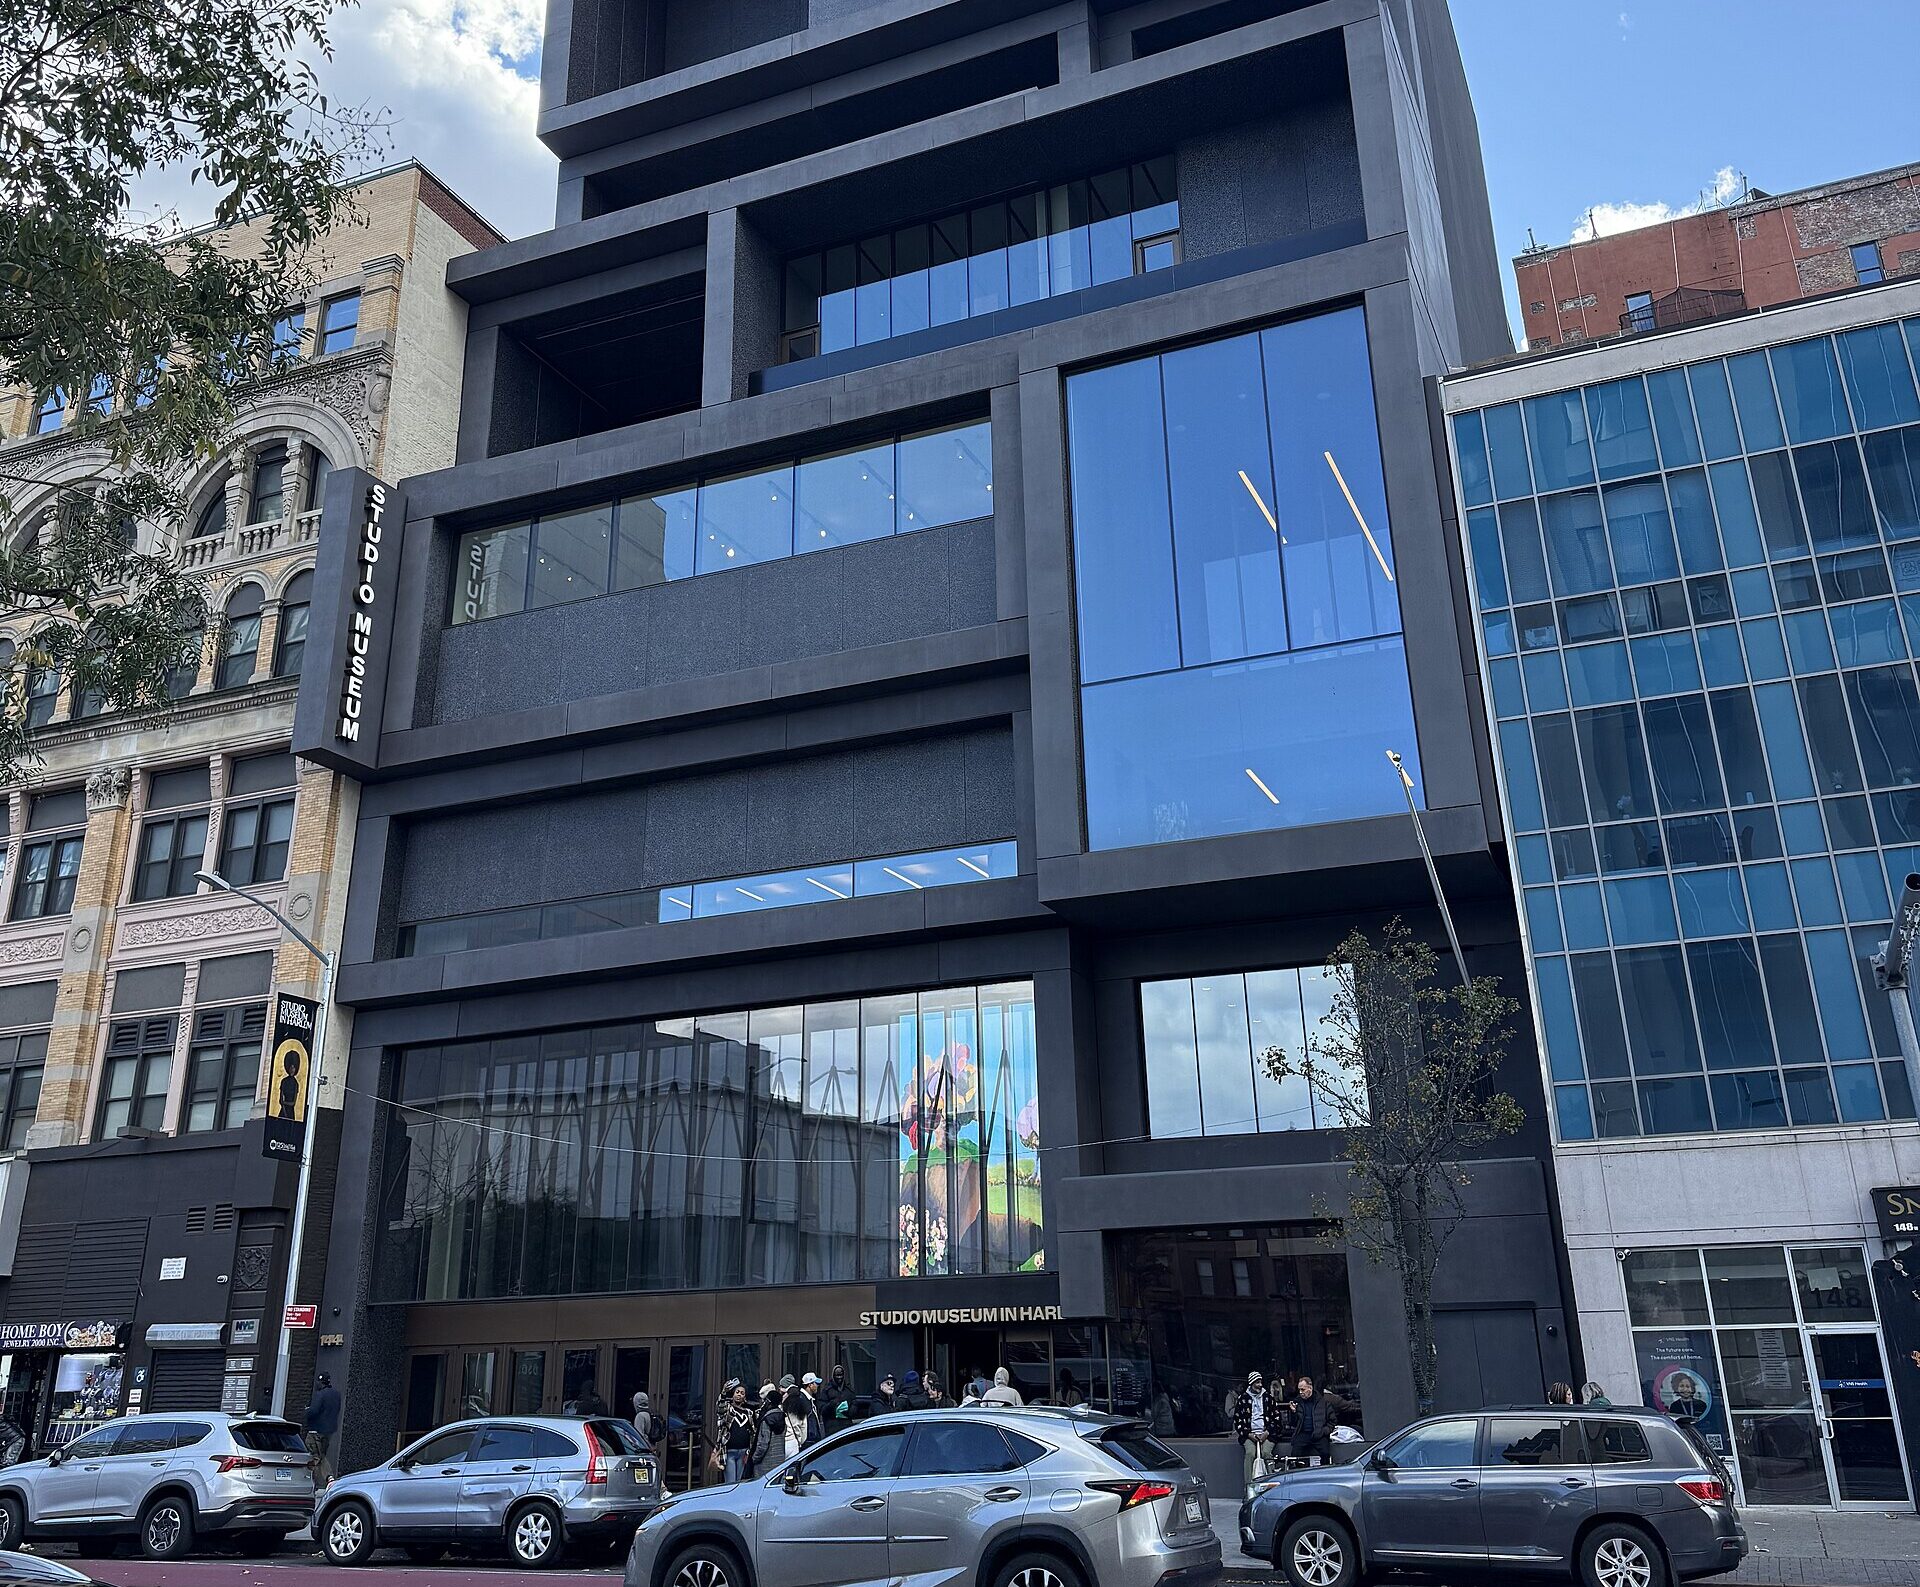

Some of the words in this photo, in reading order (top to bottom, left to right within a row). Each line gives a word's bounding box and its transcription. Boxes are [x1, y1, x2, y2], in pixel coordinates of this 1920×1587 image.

[358, 484, 386, 604] STUDIO
[341, 611, 372, 742] MUSEUM
[281, 1000, 305, 1012] STUDIO
[287, 1015, 312, 1030] HARLEM
[859, 1310, 921, 1326] STUDIO
[922, 1307, 998, 1324] MUSEUM
[1000, 1307, 1017, 1322] IN
[0, 1324, 37, 1339] HOME
[39, 1323, 66, 1338] BOY
[235, 1321, 255, 1331] NYC
[3, 1339, 30, 1348] JEWELRY
[31, 1338, 46, 1347] 2000
